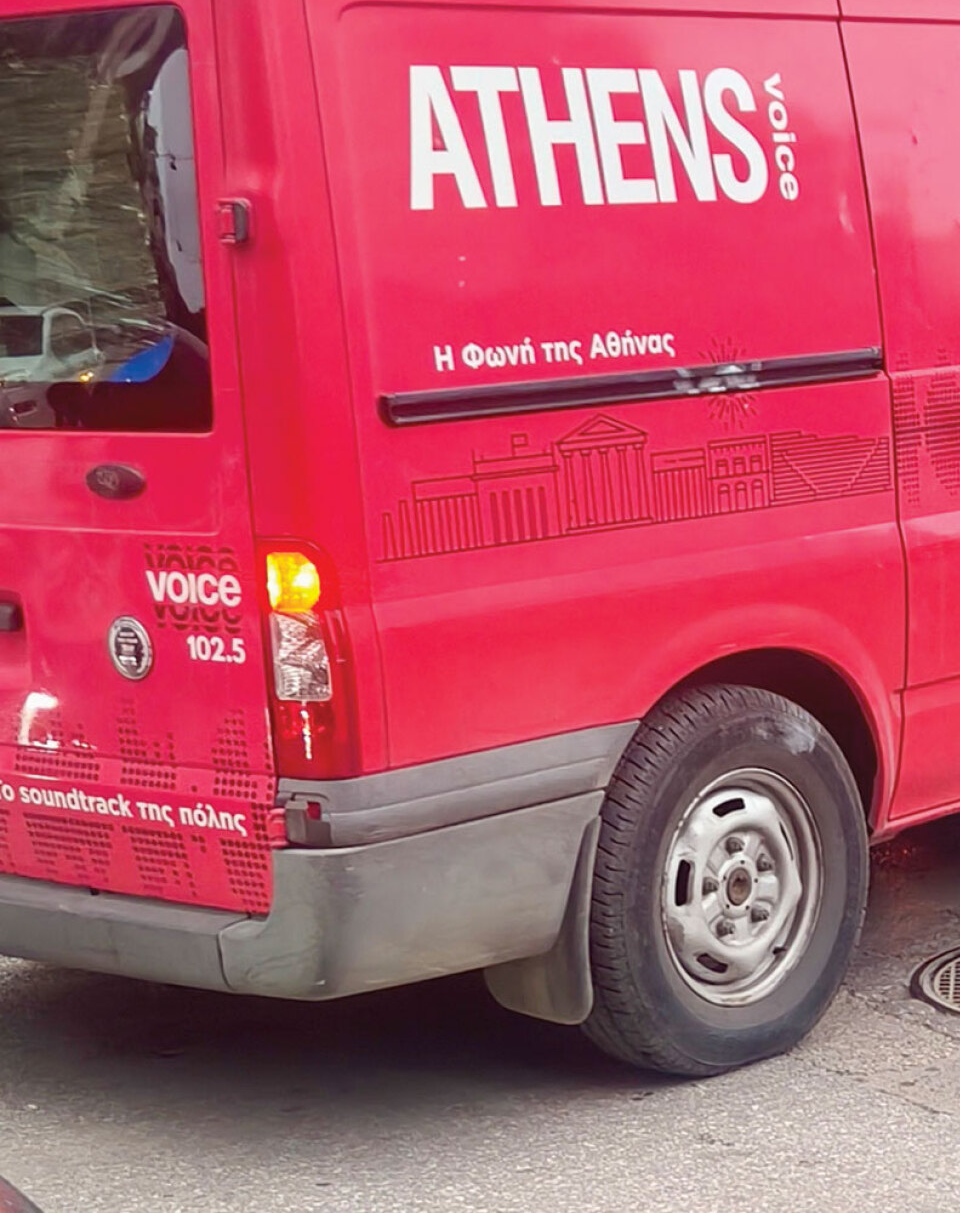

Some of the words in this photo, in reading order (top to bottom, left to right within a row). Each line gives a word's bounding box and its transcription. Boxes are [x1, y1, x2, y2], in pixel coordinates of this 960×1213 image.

[410, 65, 768, 210] ATHENS
[763, 73, 799, 201] voice
[434, 345, 454, 372] Η
[462, 337, 535, 369] Φωνή
[542, 336, 583, 364] της
[590, 329, 675, 360] Αθήνας
[186, 635, 246, 664] 102.5
[20, 789, 132, 818] soundtrack
[137, 803, 174, 827] της
[180, 803, 247, 836] πόλης
